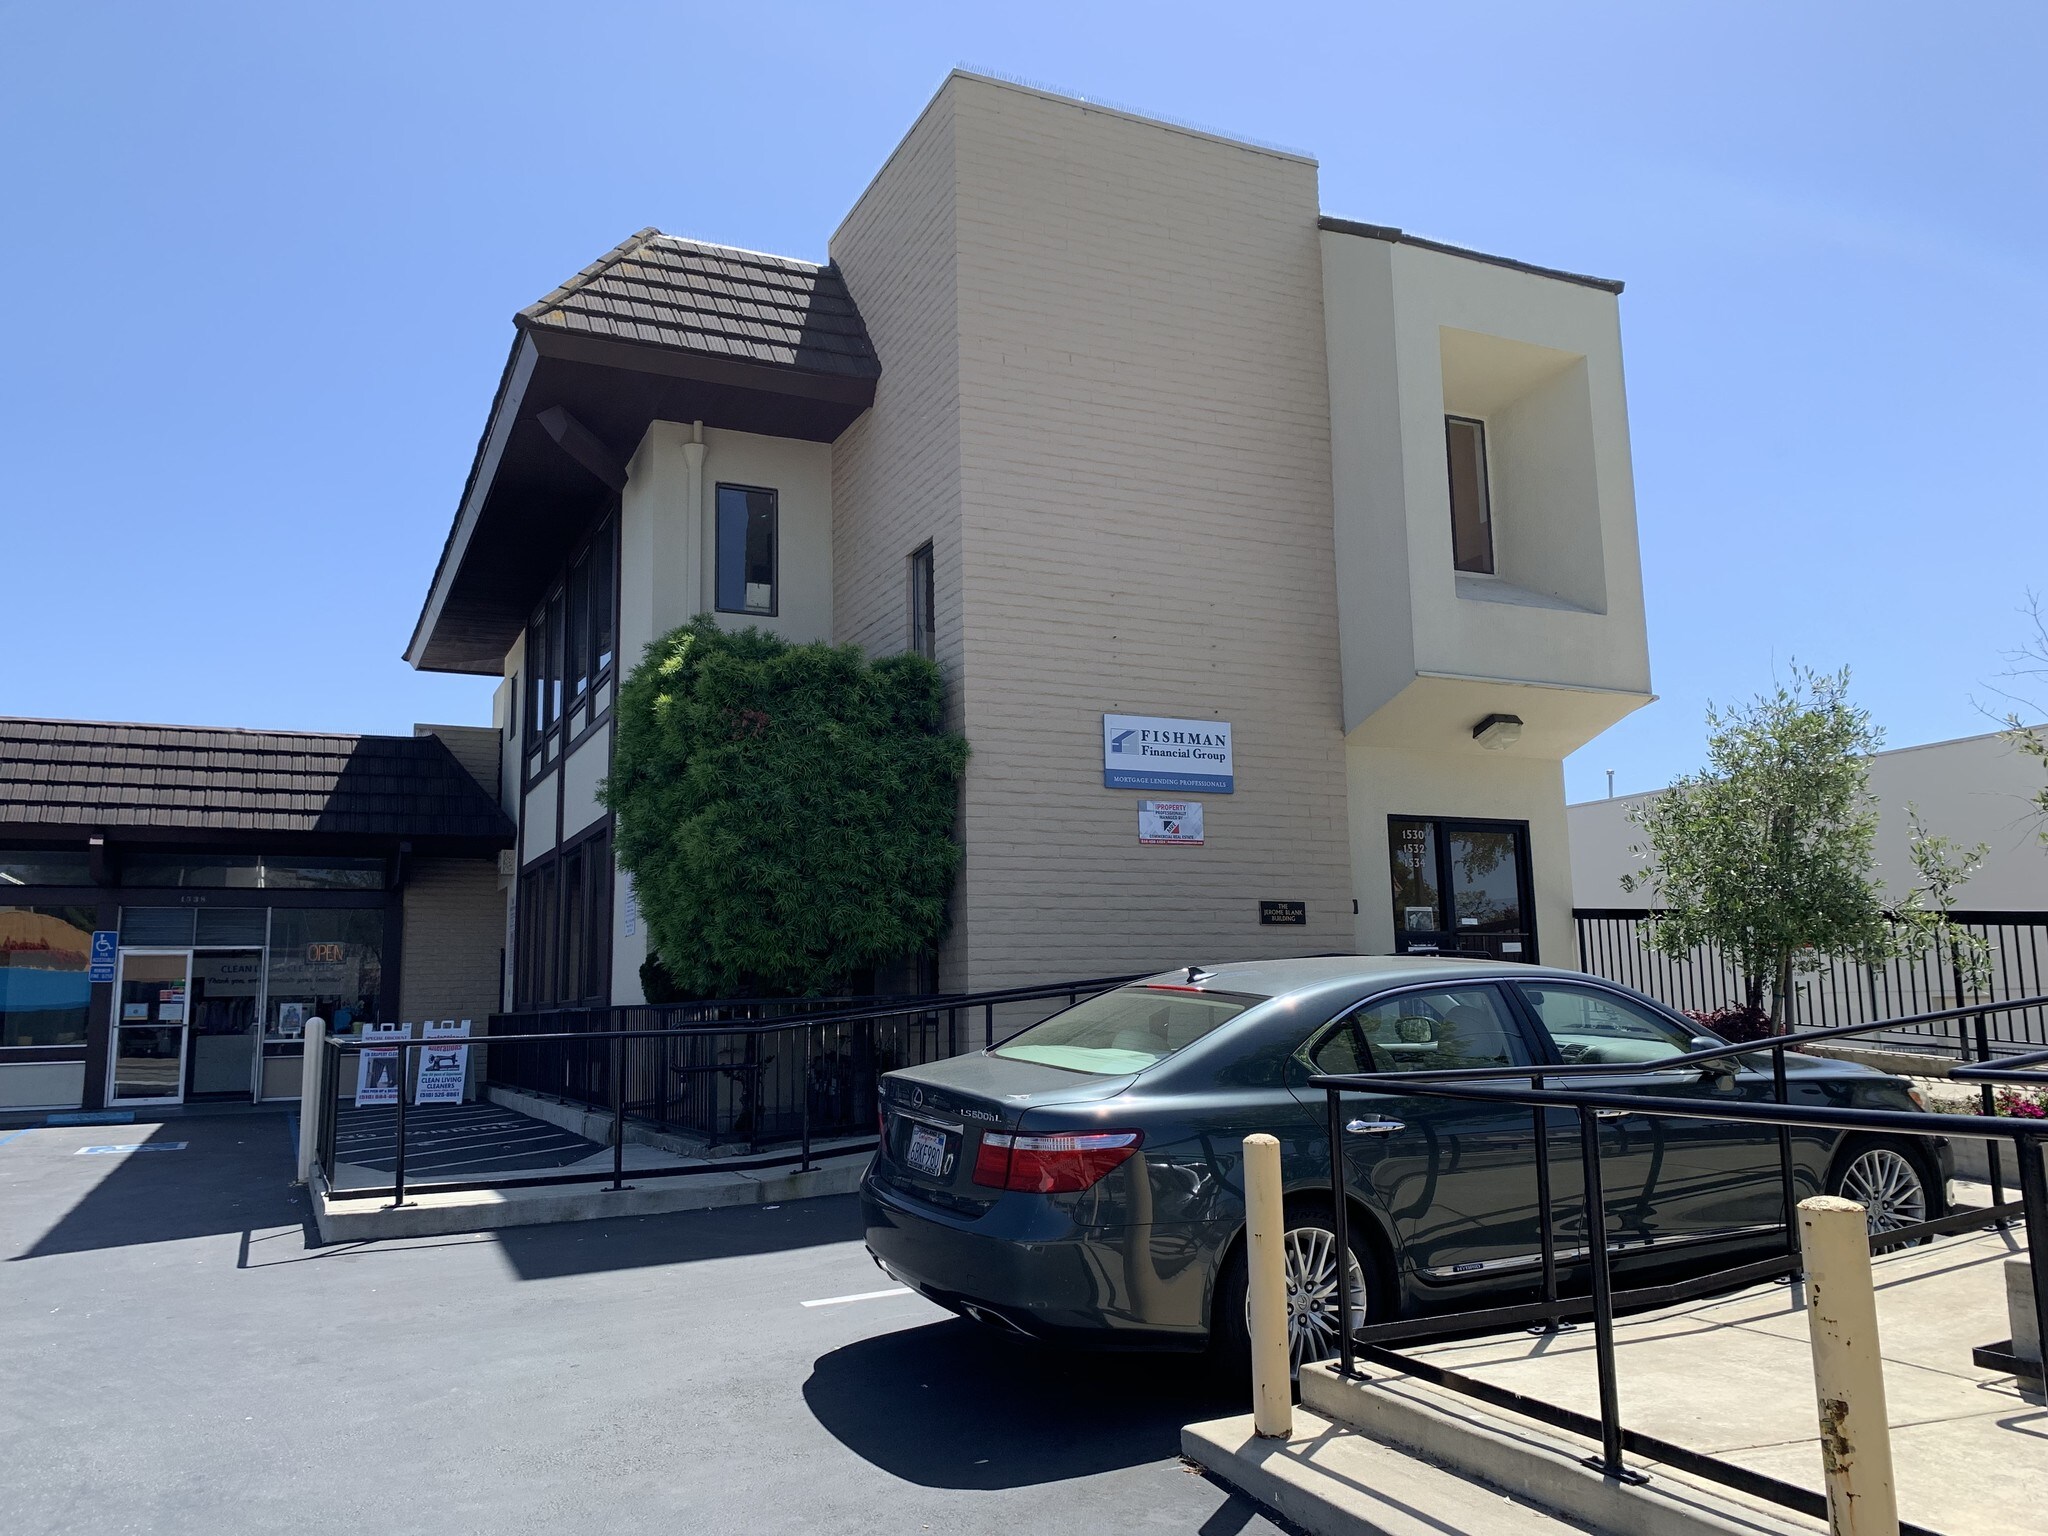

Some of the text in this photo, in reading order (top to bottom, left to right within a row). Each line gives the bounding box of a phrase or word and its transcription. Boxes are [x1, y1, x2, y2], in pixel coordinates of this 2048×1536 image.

[1141, 730, 1226, 746] FISHMAN
[1141, 746, 1226, 762] Financial Group
[1180, 780, 1226, 788] PROFESSIONALS
[1402, 830, 1424, 839] 1530
[1403, 844, 1424, 853] 1532
[1404, 858, 1425, 868] 1534
[308, 944, 343, 962] OPEN
[221, 965, 253, 973] CLEAN
